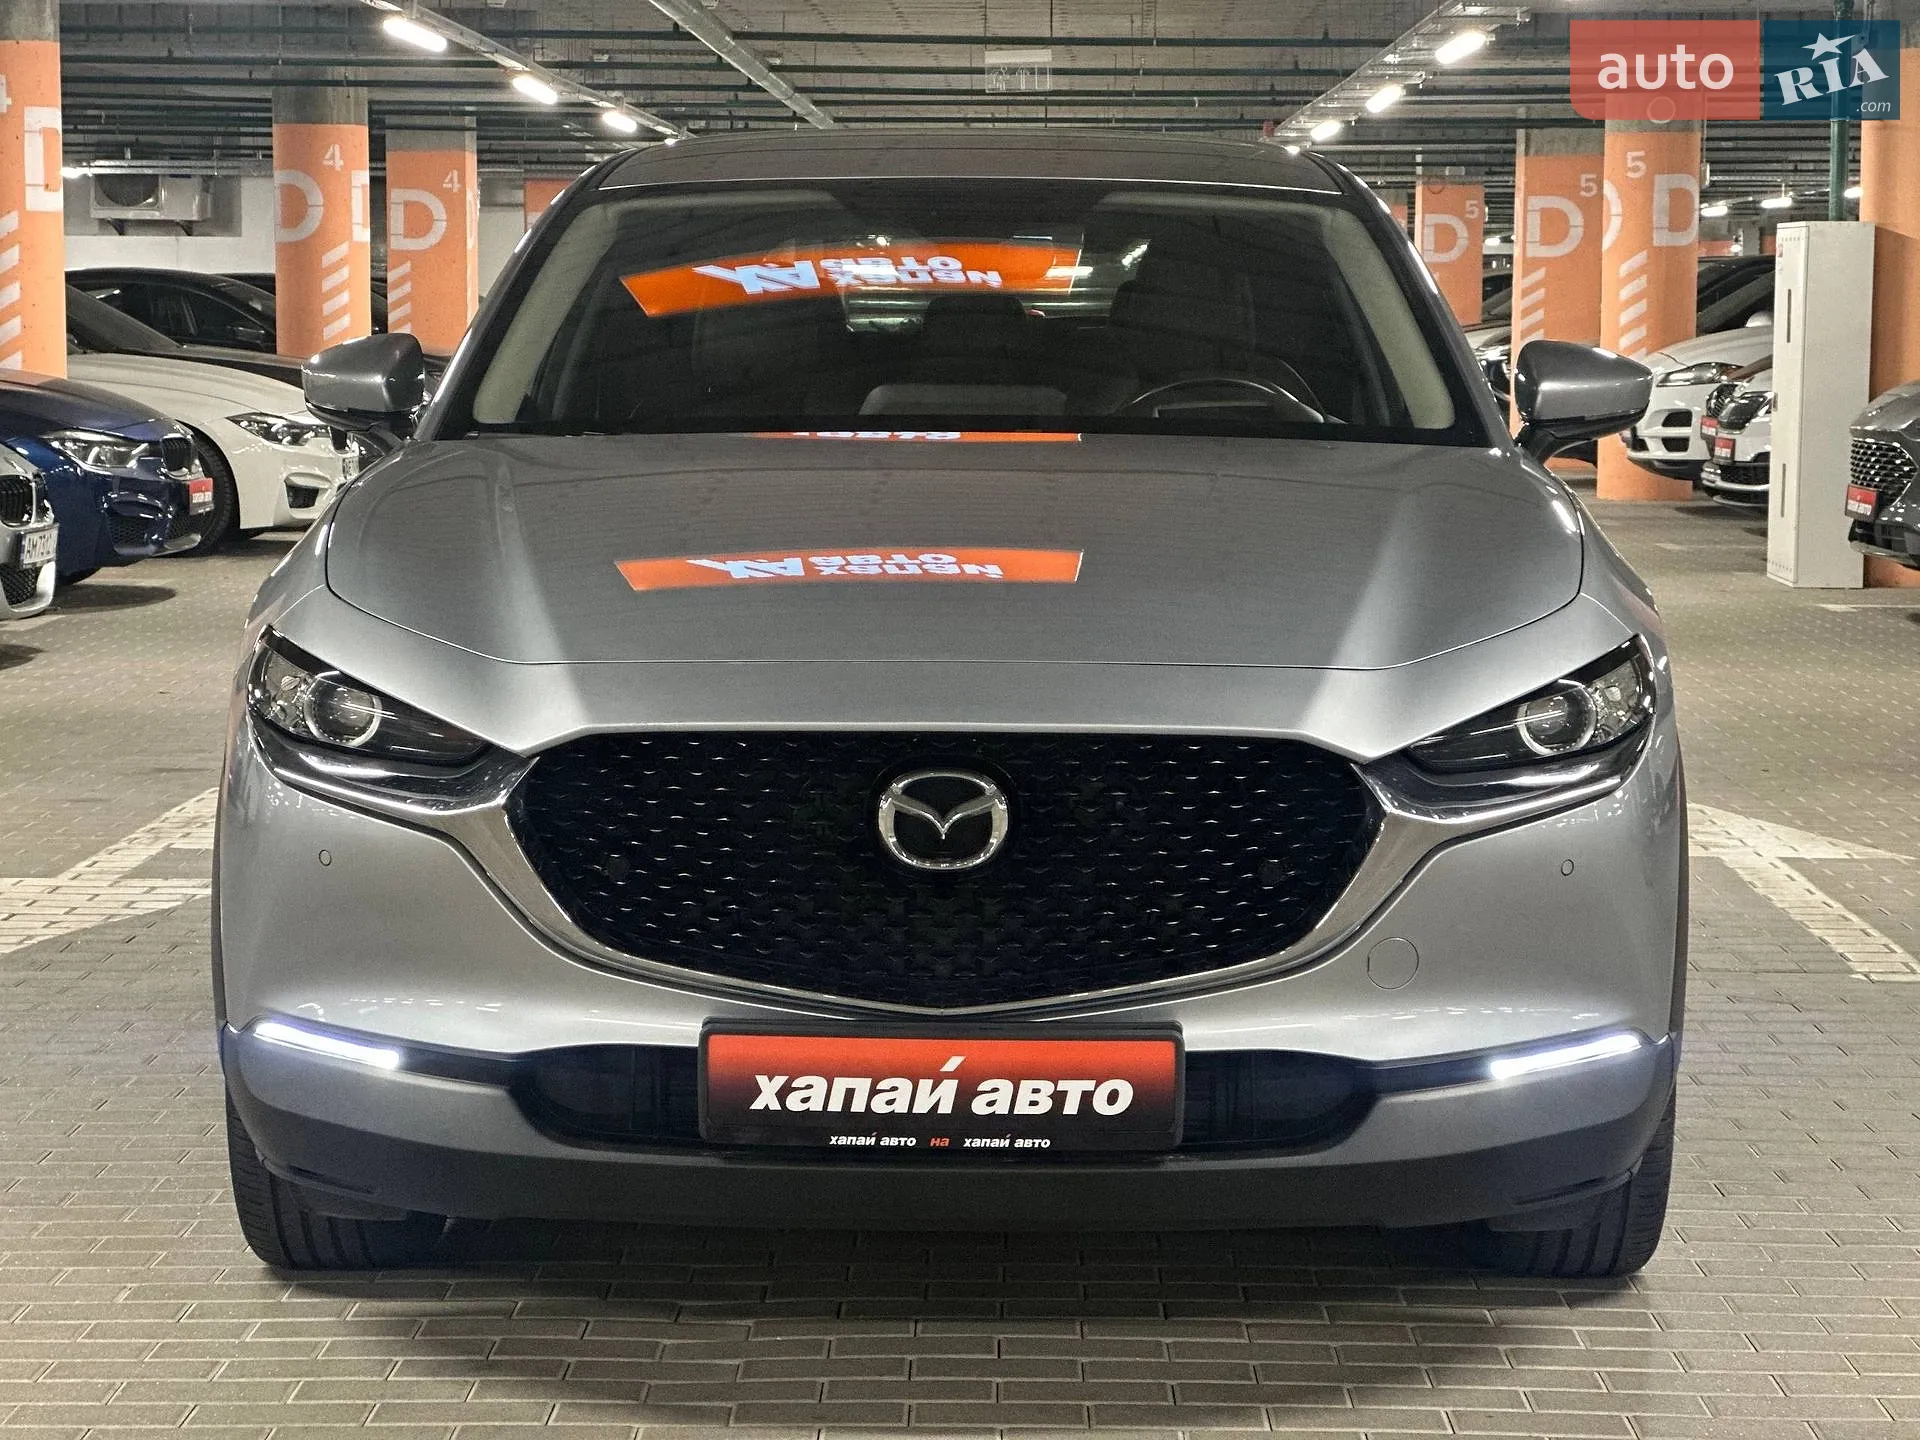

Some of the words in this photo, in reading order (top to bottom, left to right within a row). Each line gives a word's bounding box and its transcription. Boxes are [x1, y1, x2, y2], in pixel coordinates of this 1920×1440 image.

[274, 169, 324, 243] D
[323, 143, 344, 171] 4
[390, 188, 447, 250] D
[442, 169, 461, 192] 4
[1423, 213, 1469, 263] D
[1465, 200, 1480, 219] 5
[1525, 195, 1584, 257] D
[1580, 173, 1598, 197] 5
[1625, 151, 1647, 178] 5
[1653, 174, 1699, 247] D
[749, 1056, 966, 1114] хапай
[971, 1078, 1134, 1116] авто
[829, 1132, 878, 1147] хапай
[880, 1136, 917, 1147] авто
[930, 1136, 950, 1147] на
[963, 1133, 1011, 1149] хапай
[1014, 1138, 1051, 1148] авто
